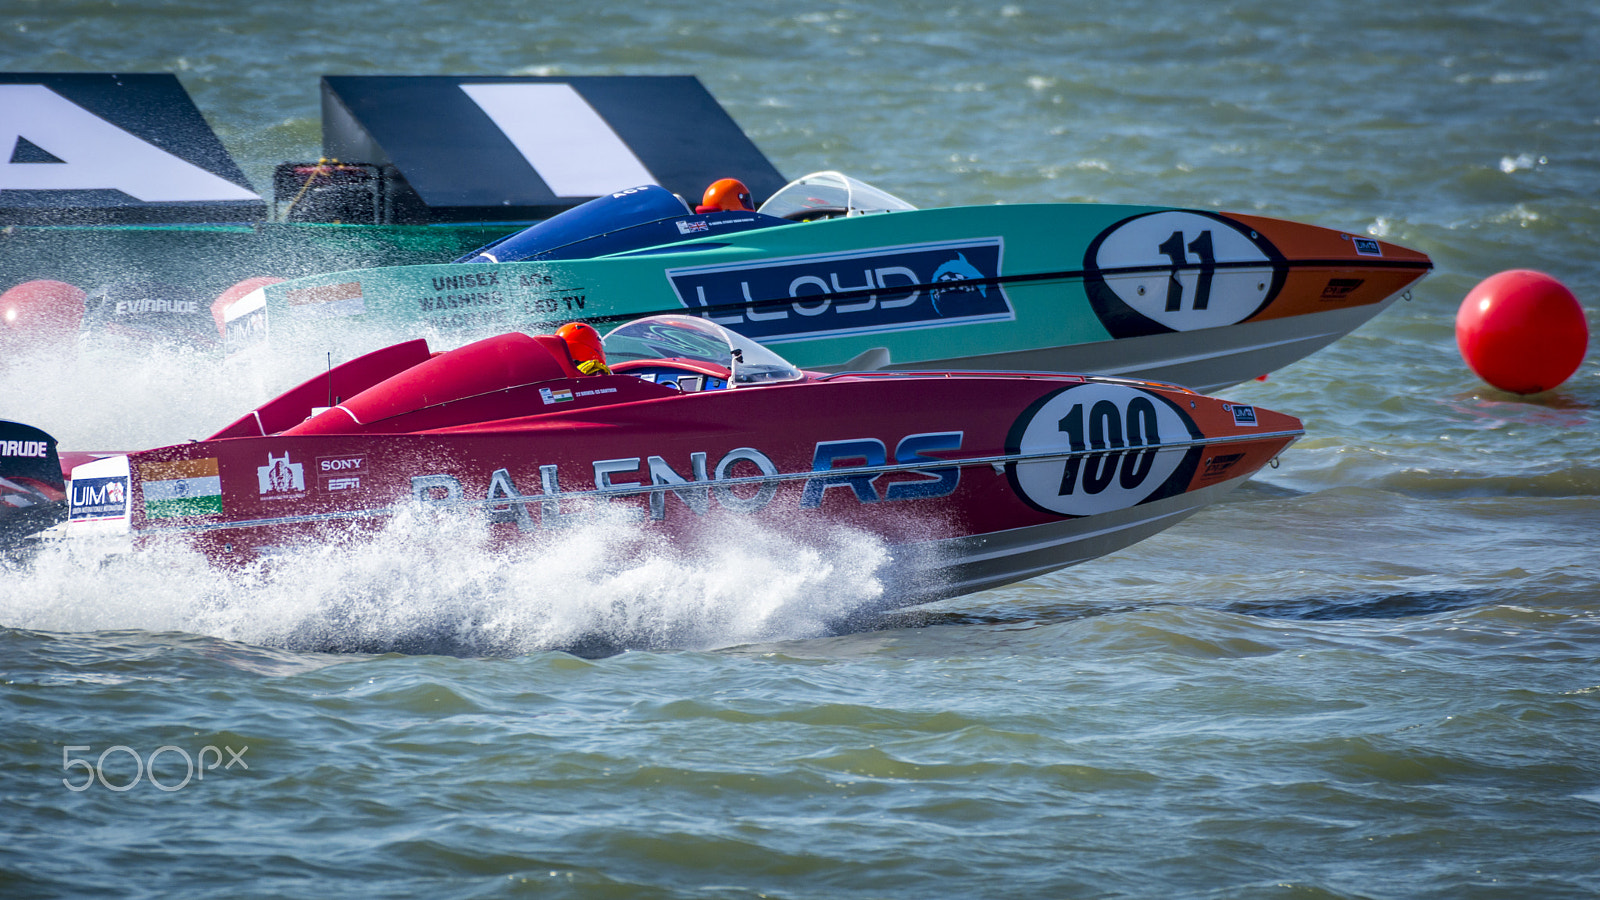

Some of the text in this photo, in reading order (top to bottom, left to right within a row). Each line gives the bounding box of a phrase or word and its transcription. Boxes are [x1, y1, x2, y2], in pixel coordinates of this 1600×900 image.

[432, 271, 500, 291] UNISEX
[1159, 230, 1216, 312] 11
[418, 291, 504, 311] WASHING
[524, 295, 586, 315] LED TV
[696, 266, 921, 326] LLOYD
[1058, 396, 1161, 496] 100
[320, 458, 363, 471] SONY
[801, 431, 964, 510] RS
[328, 477, 360, 491] ESPN
[73, 484, 106, 507] UIM
